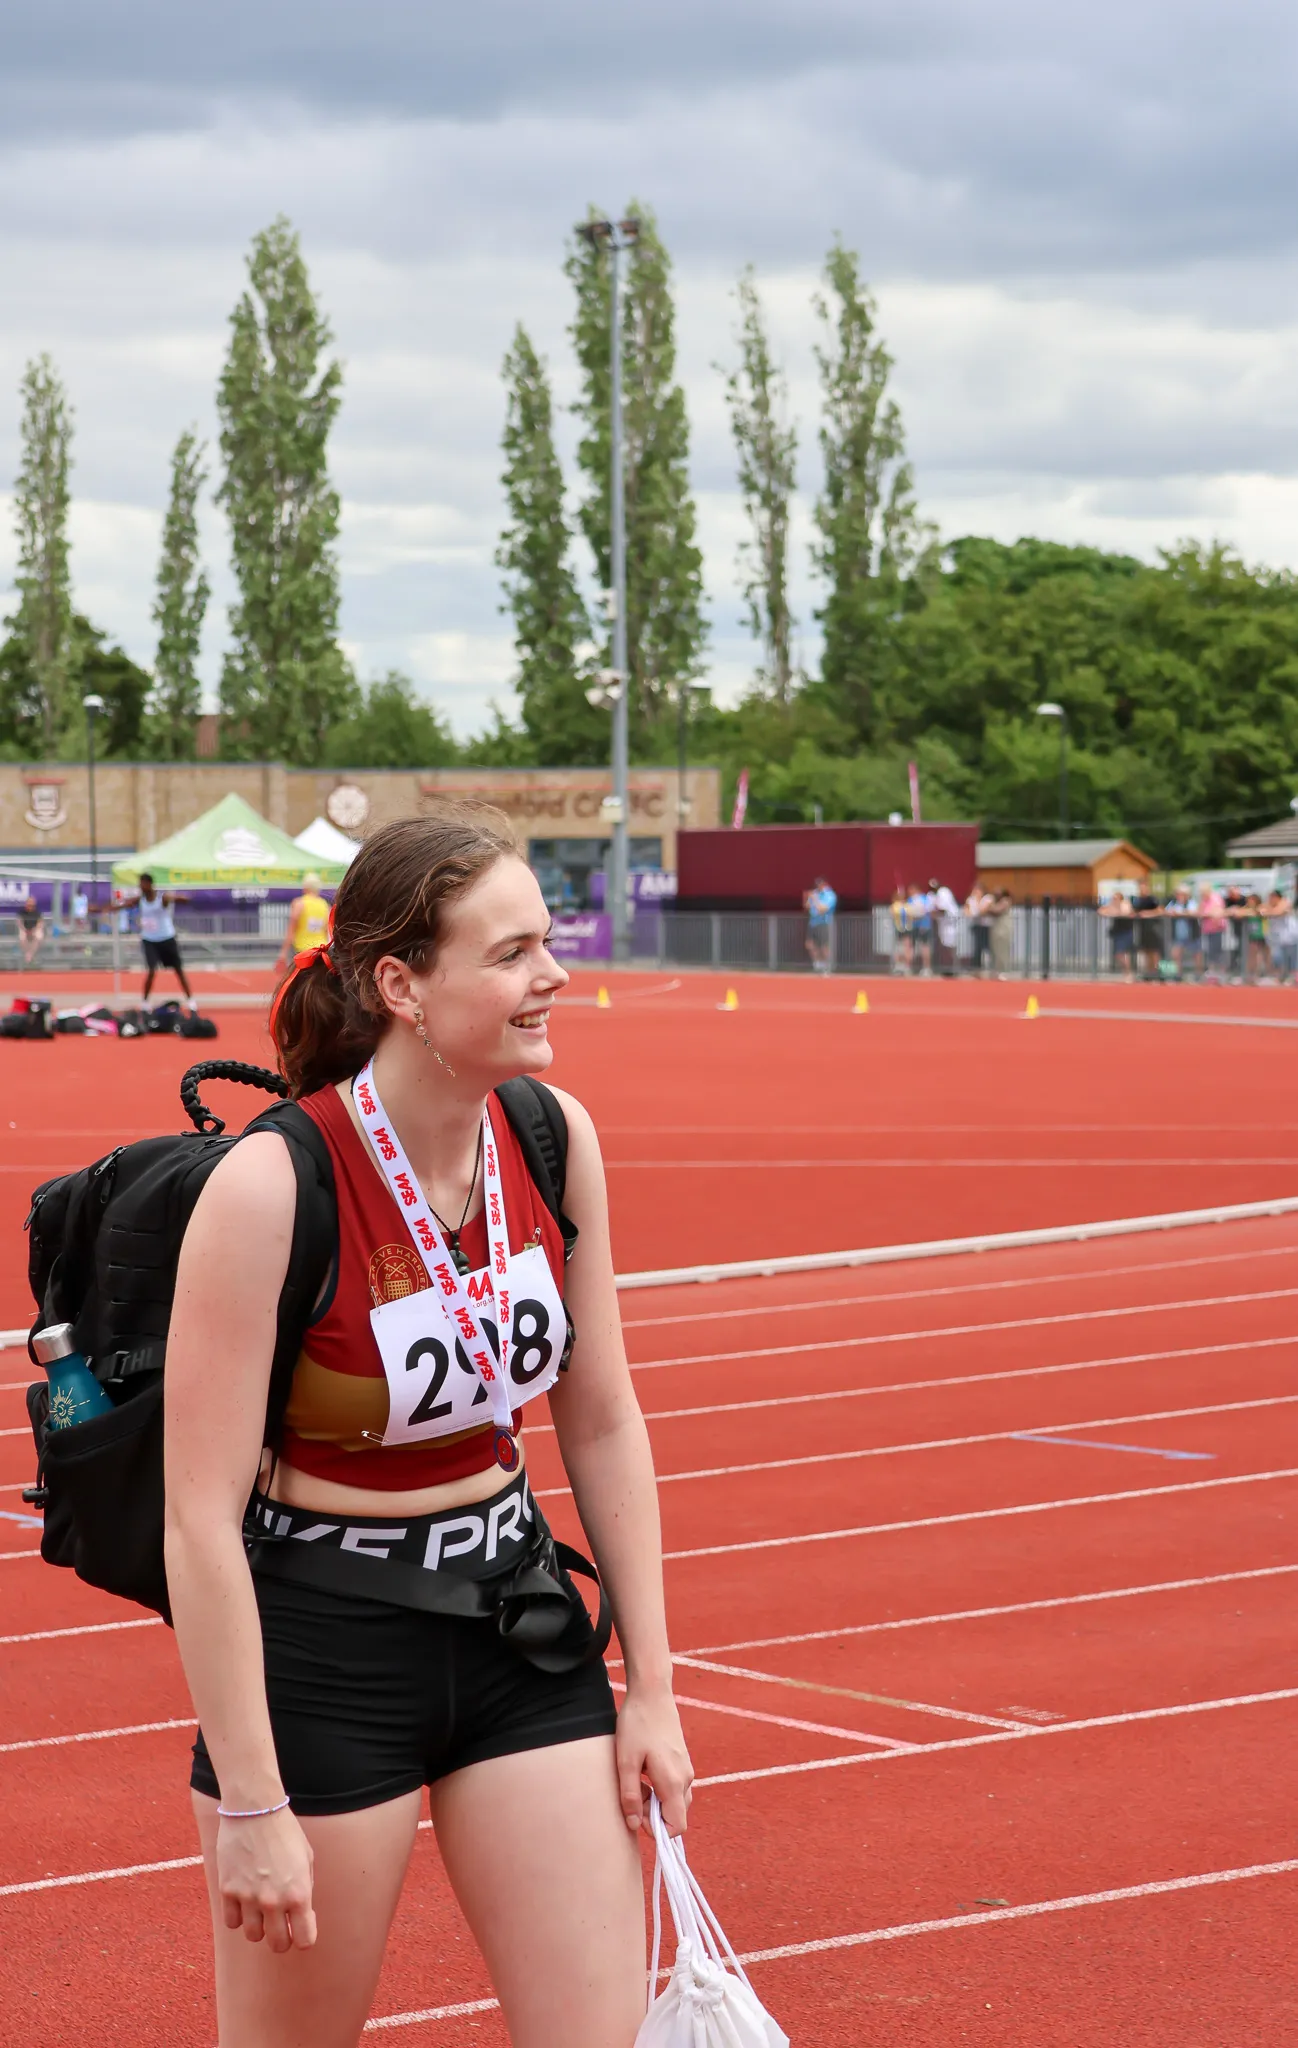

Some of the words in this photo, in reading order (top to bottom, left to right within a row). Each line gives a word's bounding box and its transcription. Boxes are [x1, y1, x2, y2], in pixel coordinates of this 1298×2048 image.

[358, 1082, 376, 1115] SEAA
[373, 1127, 397, 1161] SEAA
[487, 1144, 496, 1177] SEAA
[394, 1172, 417, 1206] SEAA
[489, 1193, 501, 1226] SEAA
[414, 1218, 437, 1251] SEAA
[494, 1242, 506, 1275] SEAA
[434, 1263, 457, 1296] SEAA
[454, 1307, 477, 1340] SEAA
[499, 1290, 510, 1324] SEAA
[473, 1351, 496, 1381] SEAA
